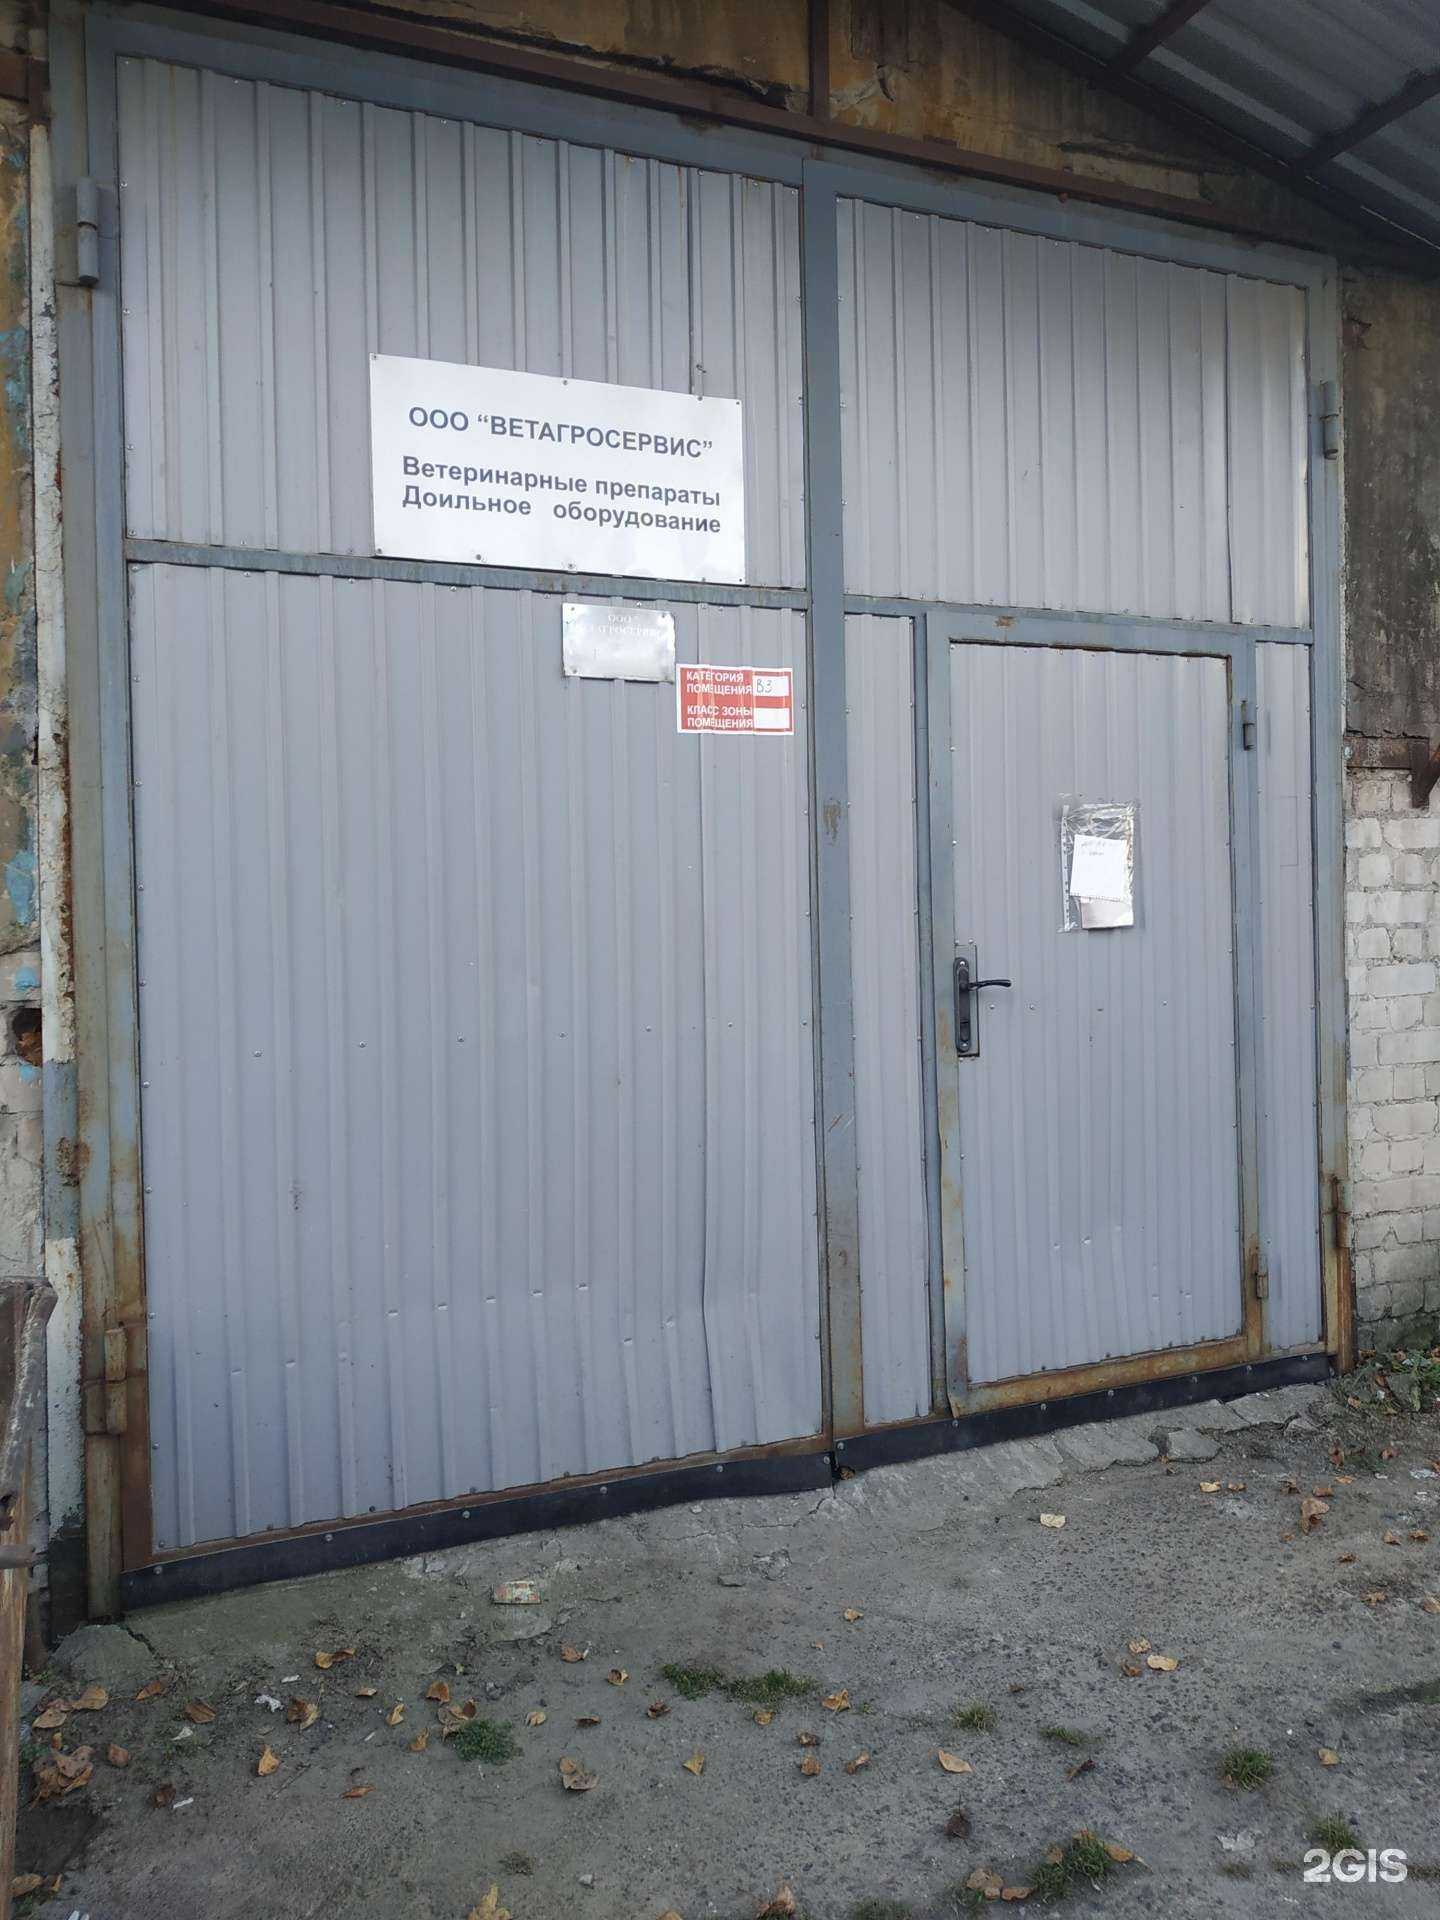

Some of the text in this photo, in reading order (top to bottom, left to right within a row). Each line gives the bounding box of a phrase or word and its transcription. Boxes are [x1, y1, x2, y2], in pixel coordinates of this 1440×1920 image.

[408, 406, 469, 432] ООО
[402, 455, 721, 507] Ветеринарные препараты
[402, 485, 721, 533] Доильное оборудование
[686, 671, 744, 682] КАТЕГОРИЯ
[686, 683, 753, 695] ПОМЕЩЕНИЯ
[687, 705, 753, 716] КЛАСС ЗОНЫ
[687, 717, 753, 729] ПОМЕЩЕНИЯ
